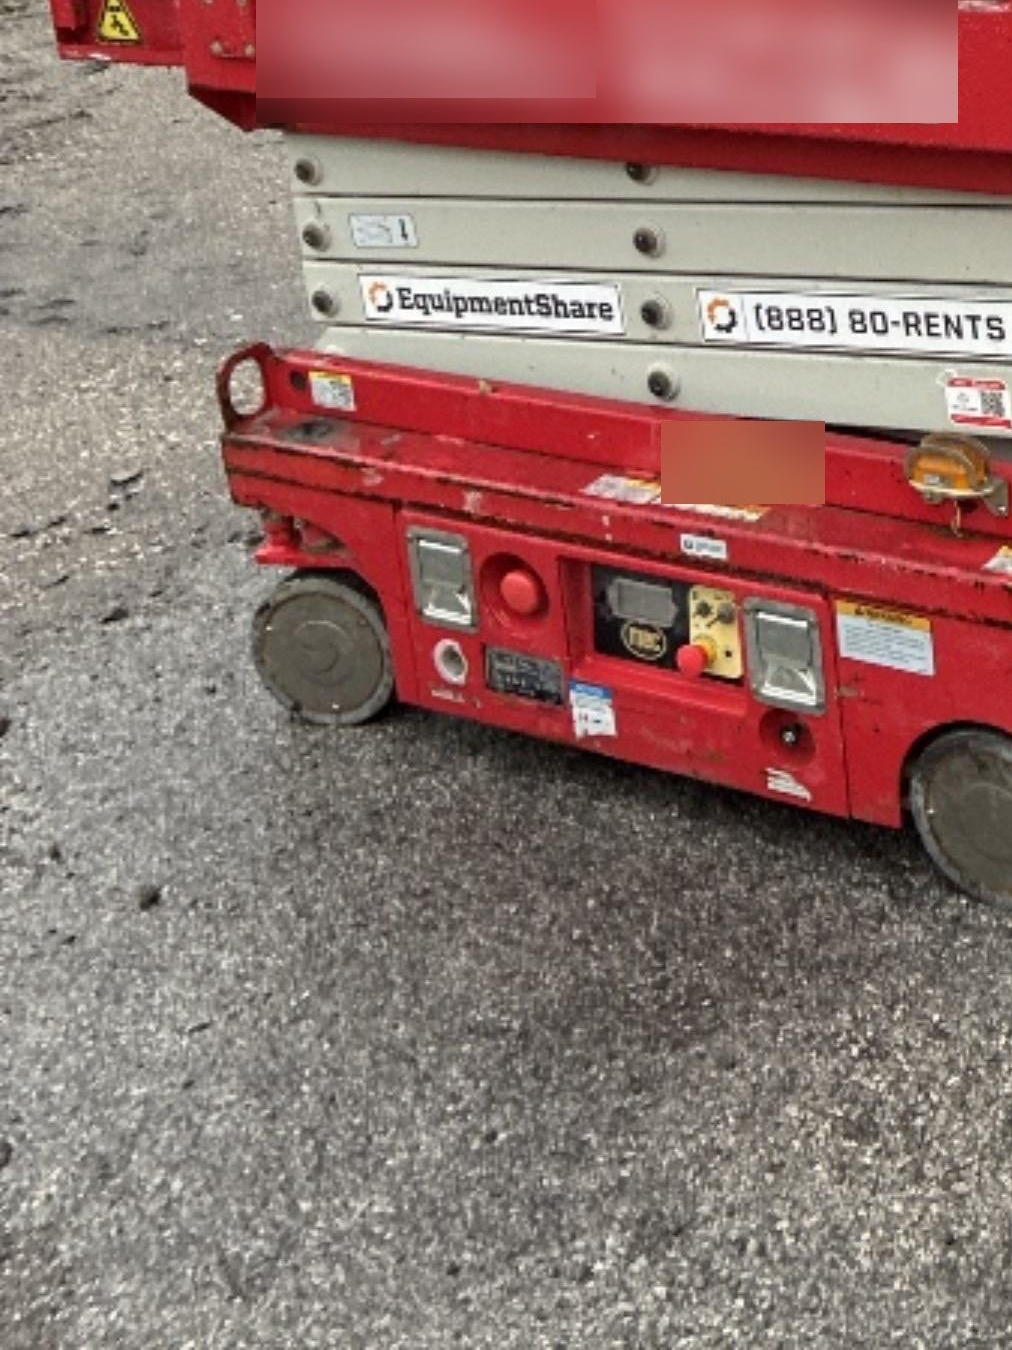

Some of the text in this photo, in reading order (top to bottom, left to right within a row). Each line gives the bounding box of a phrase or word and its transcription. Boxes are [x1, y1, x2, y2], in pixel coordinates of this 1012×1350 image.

[396, 286, 614, 322] EquipmentShare
[753, 303, 1007, 341] (888) 80-RENTS
